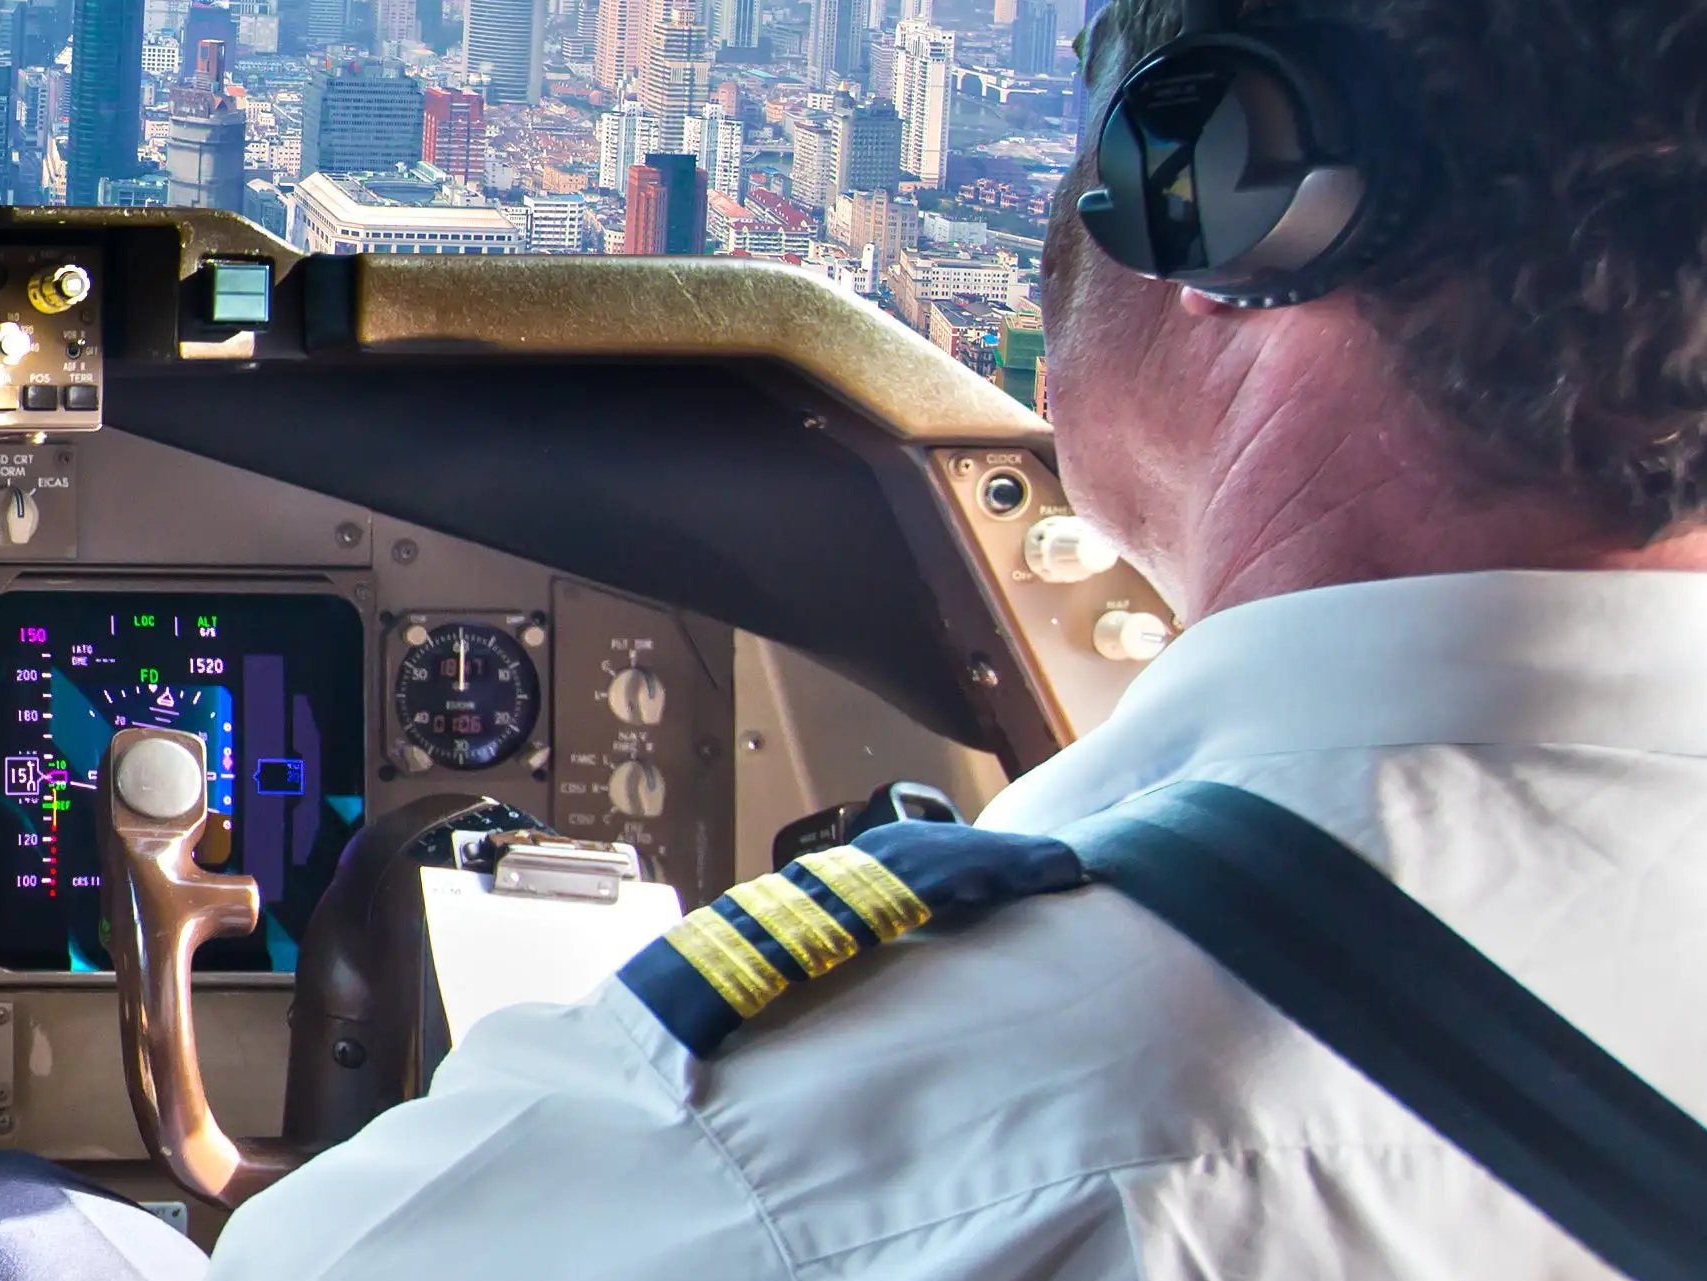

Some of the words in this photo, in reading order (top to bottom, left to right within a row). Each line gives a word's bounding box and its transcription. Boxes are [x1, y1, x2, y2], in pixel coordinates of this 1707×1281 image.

[67, 372, 94, 384] TERR
[13, 453, 34, 465] CRT
[189, 657, 226, 674] 1520
